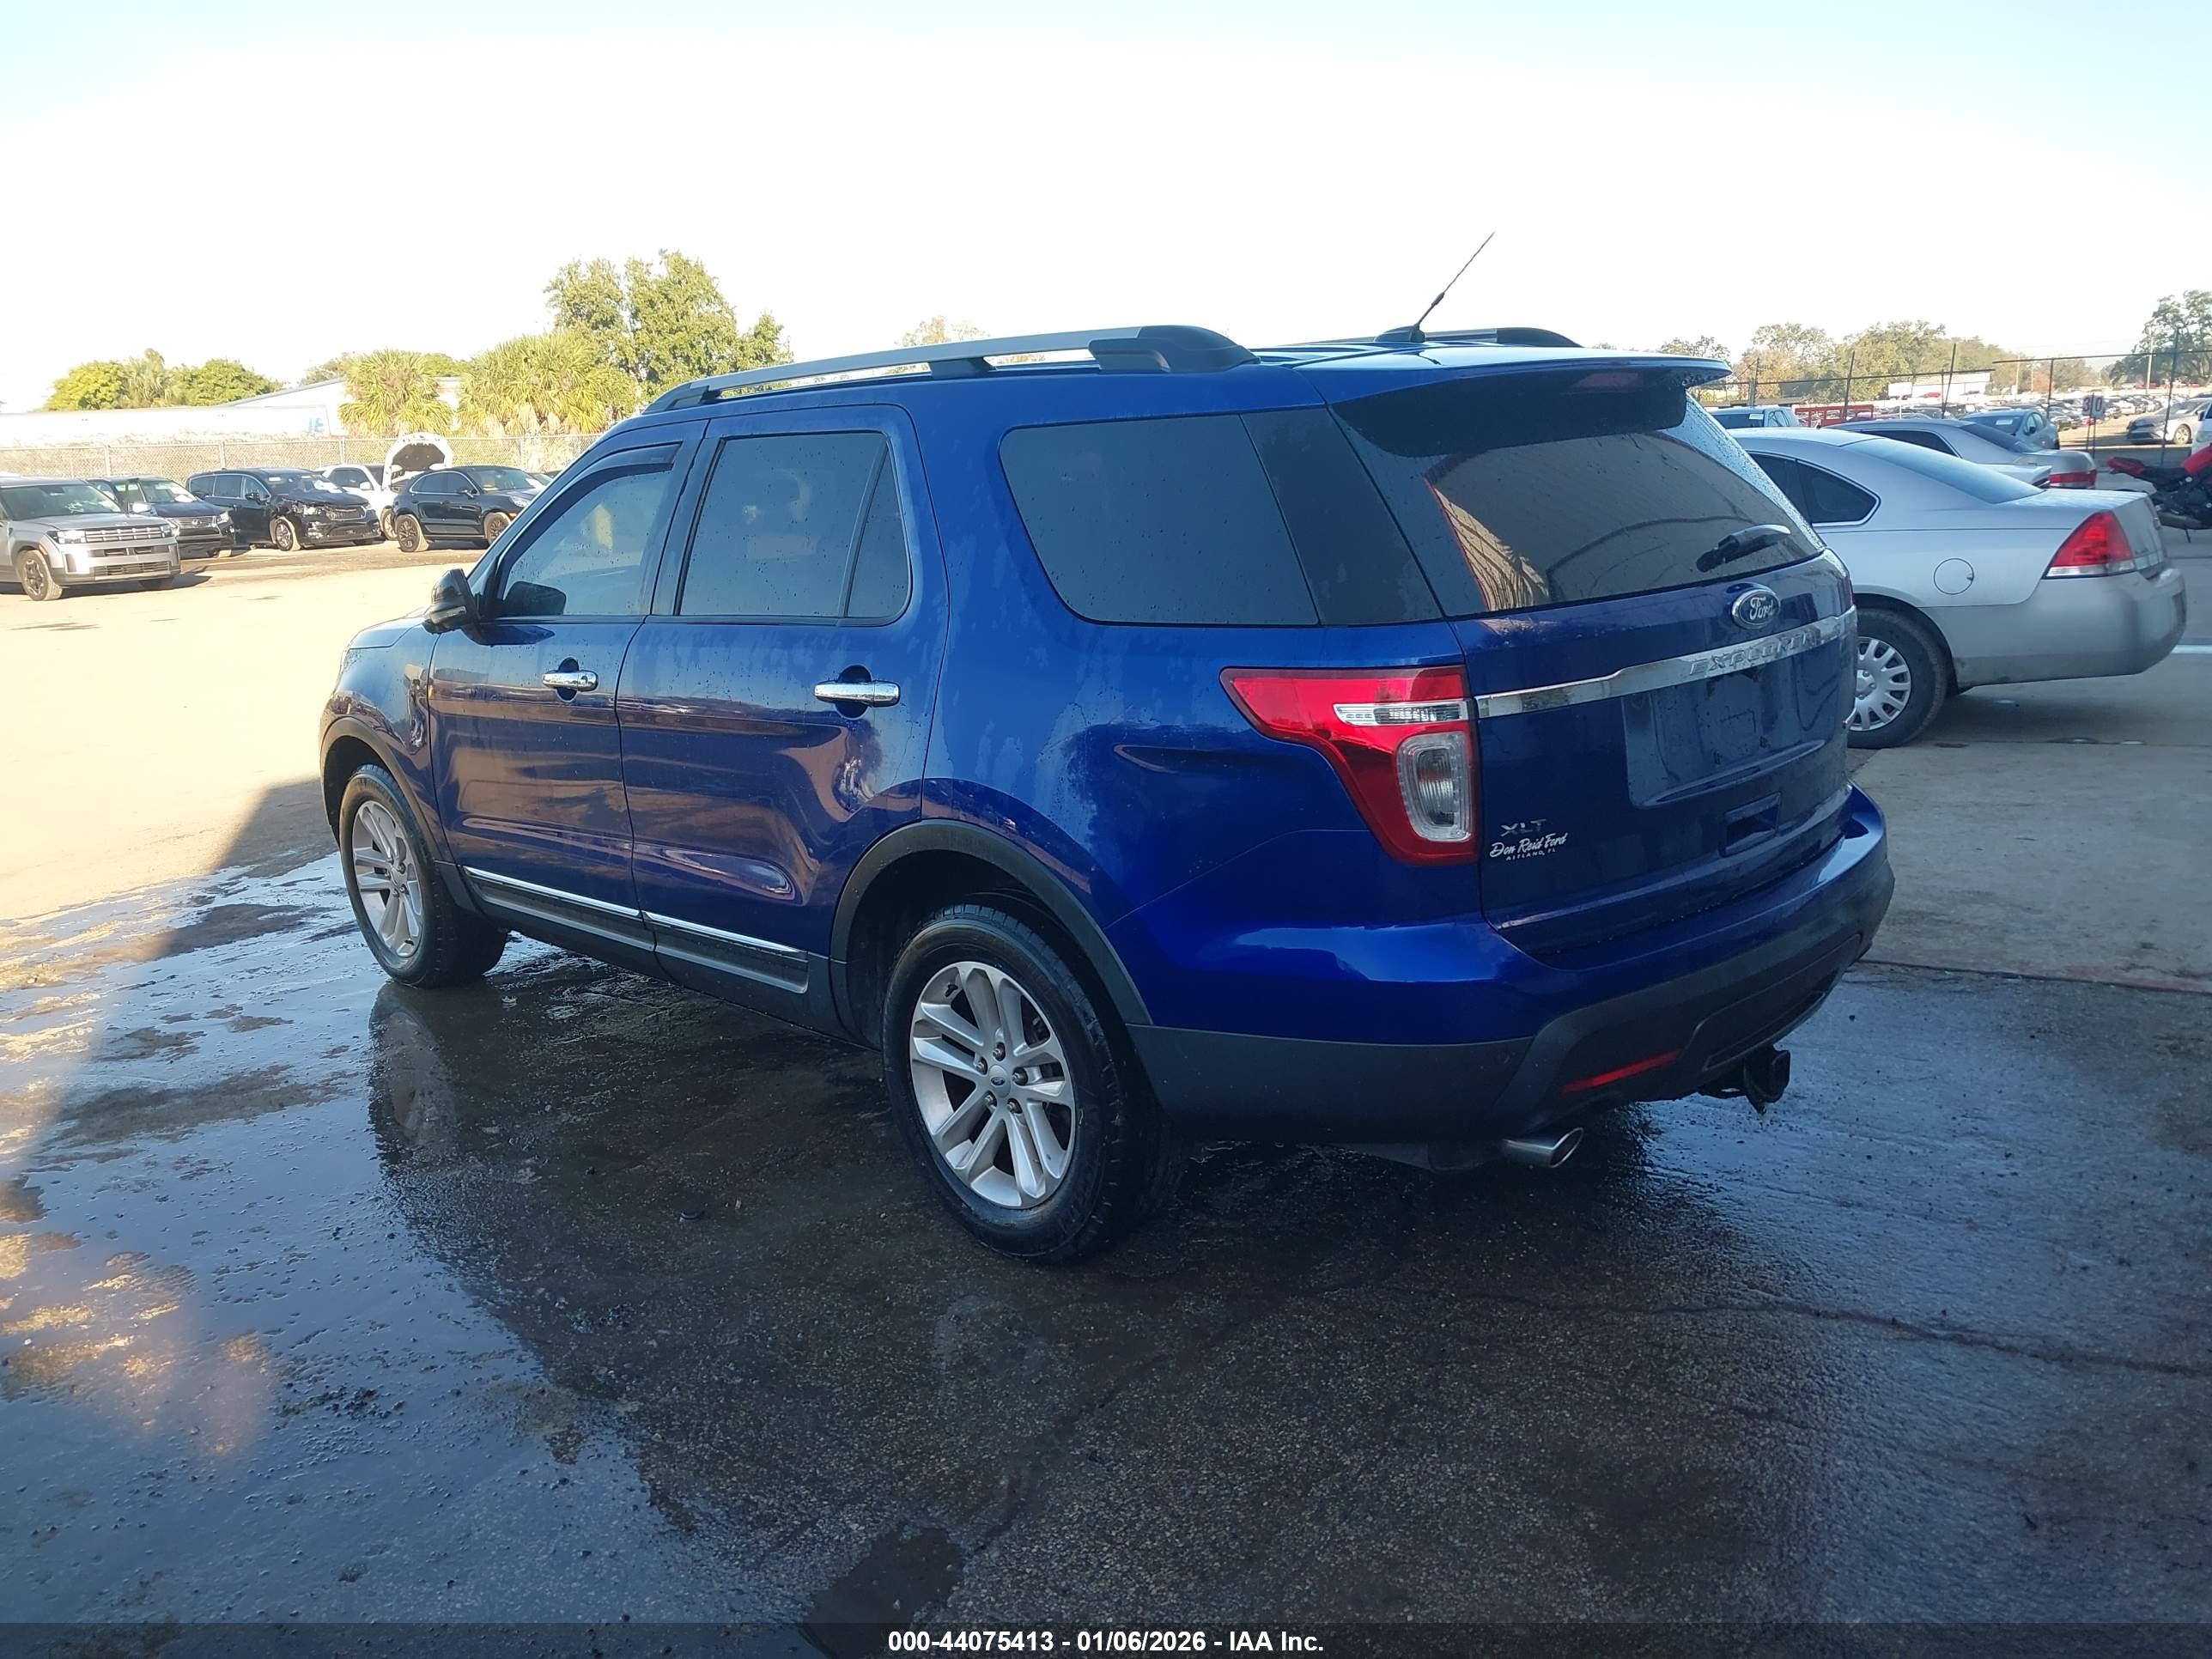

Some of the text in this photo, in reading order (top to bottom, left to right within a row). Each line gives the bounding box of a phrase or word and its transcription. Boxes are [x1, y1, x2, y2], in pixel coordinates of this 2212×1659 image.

[1749, 596, 1775, 621] Ford
[1500, 818, 1547, 836] XLT
[1489, 832, 1569, 857] Don Reid Ford
